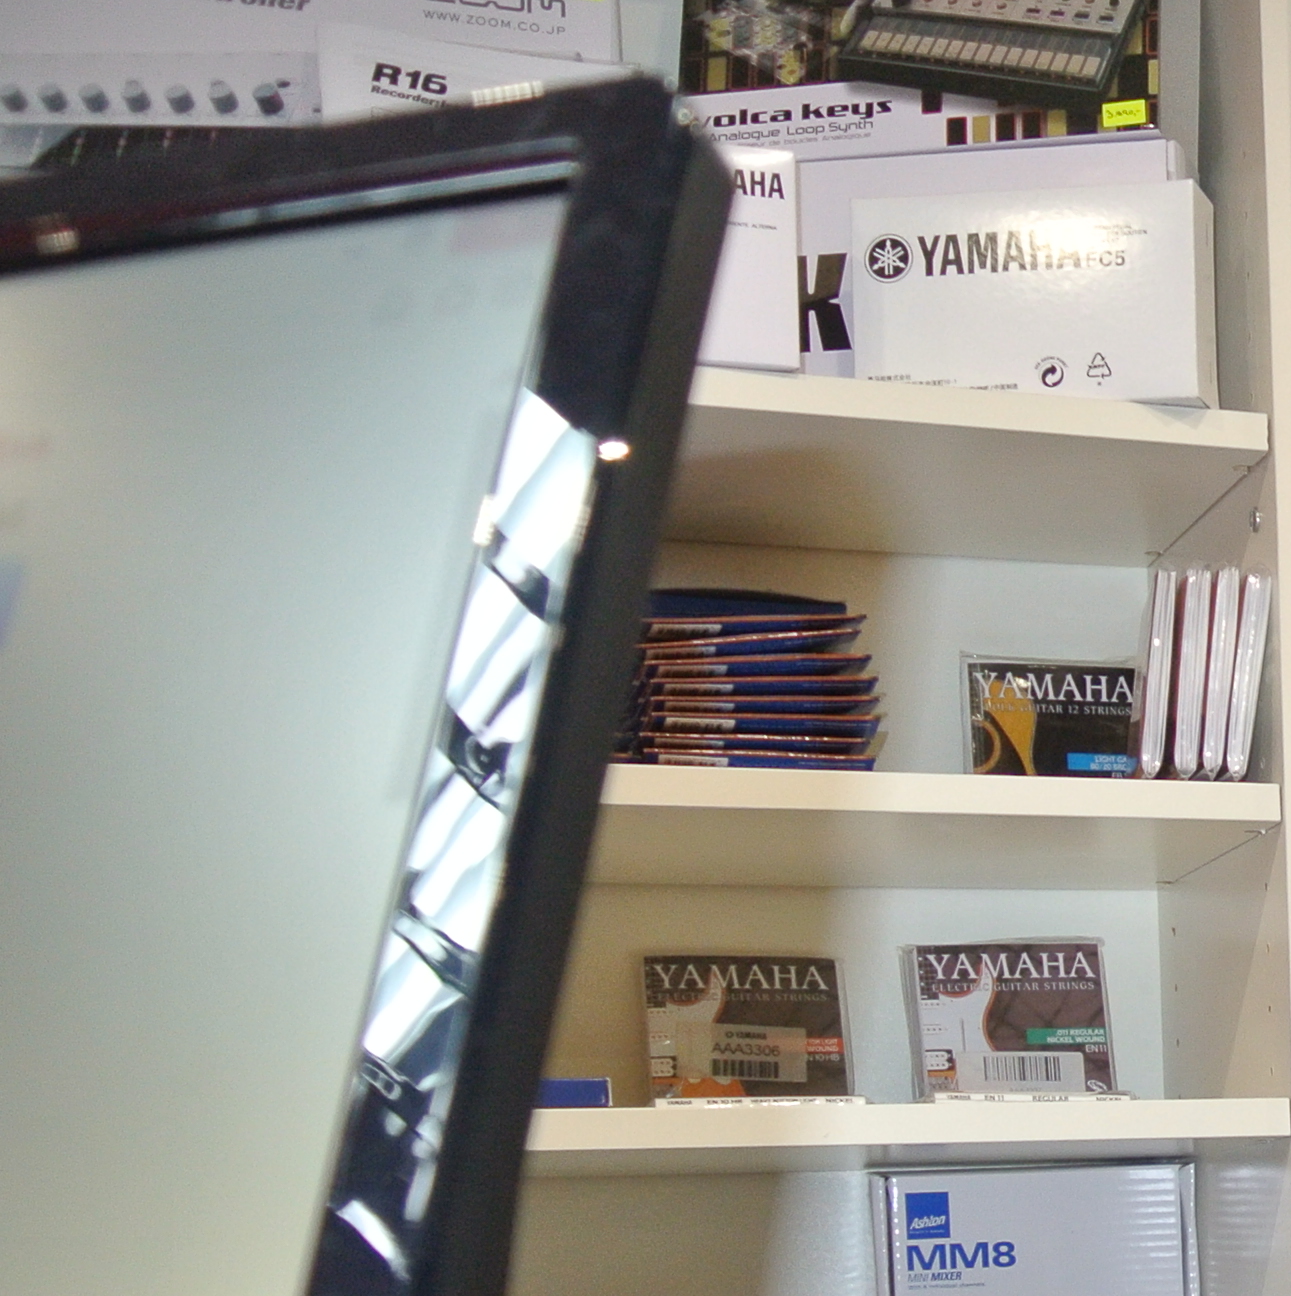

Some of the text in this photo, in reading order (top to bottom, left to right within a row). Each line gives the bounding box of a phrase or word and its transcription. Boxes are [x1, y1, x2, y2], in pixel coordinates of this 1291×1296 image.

[422, 8, 567, 36] WWW.ZOOM.CO.JP
[371, 62, 448, 96] R16
[802, 99, 893, 120] keys
[709, 119, 874, 143] Analogue Loop Synth
[917, 230, 1081, 277] YAMAHA
[1087, 250, 1126, 268] FC5
[972, 671, 1133, 703] YAMAHA
[1066, 705, 1133, 717] 12 STRINGS
[654, 963, 830, 991] YAMAHA
[927, 951, 1097, 981] YAMAHA
[994, 981, 1041, 992] GUITAR
[1044, 980, 1096, 991] STRINGS
[711, 1041, 781, 1057] AAA3306
[909, 1214, 947, 1230] Ashton
[906, 1240, 1017, 1272] MM8
[907, 1271, 963, 1283] MINI MIXER
